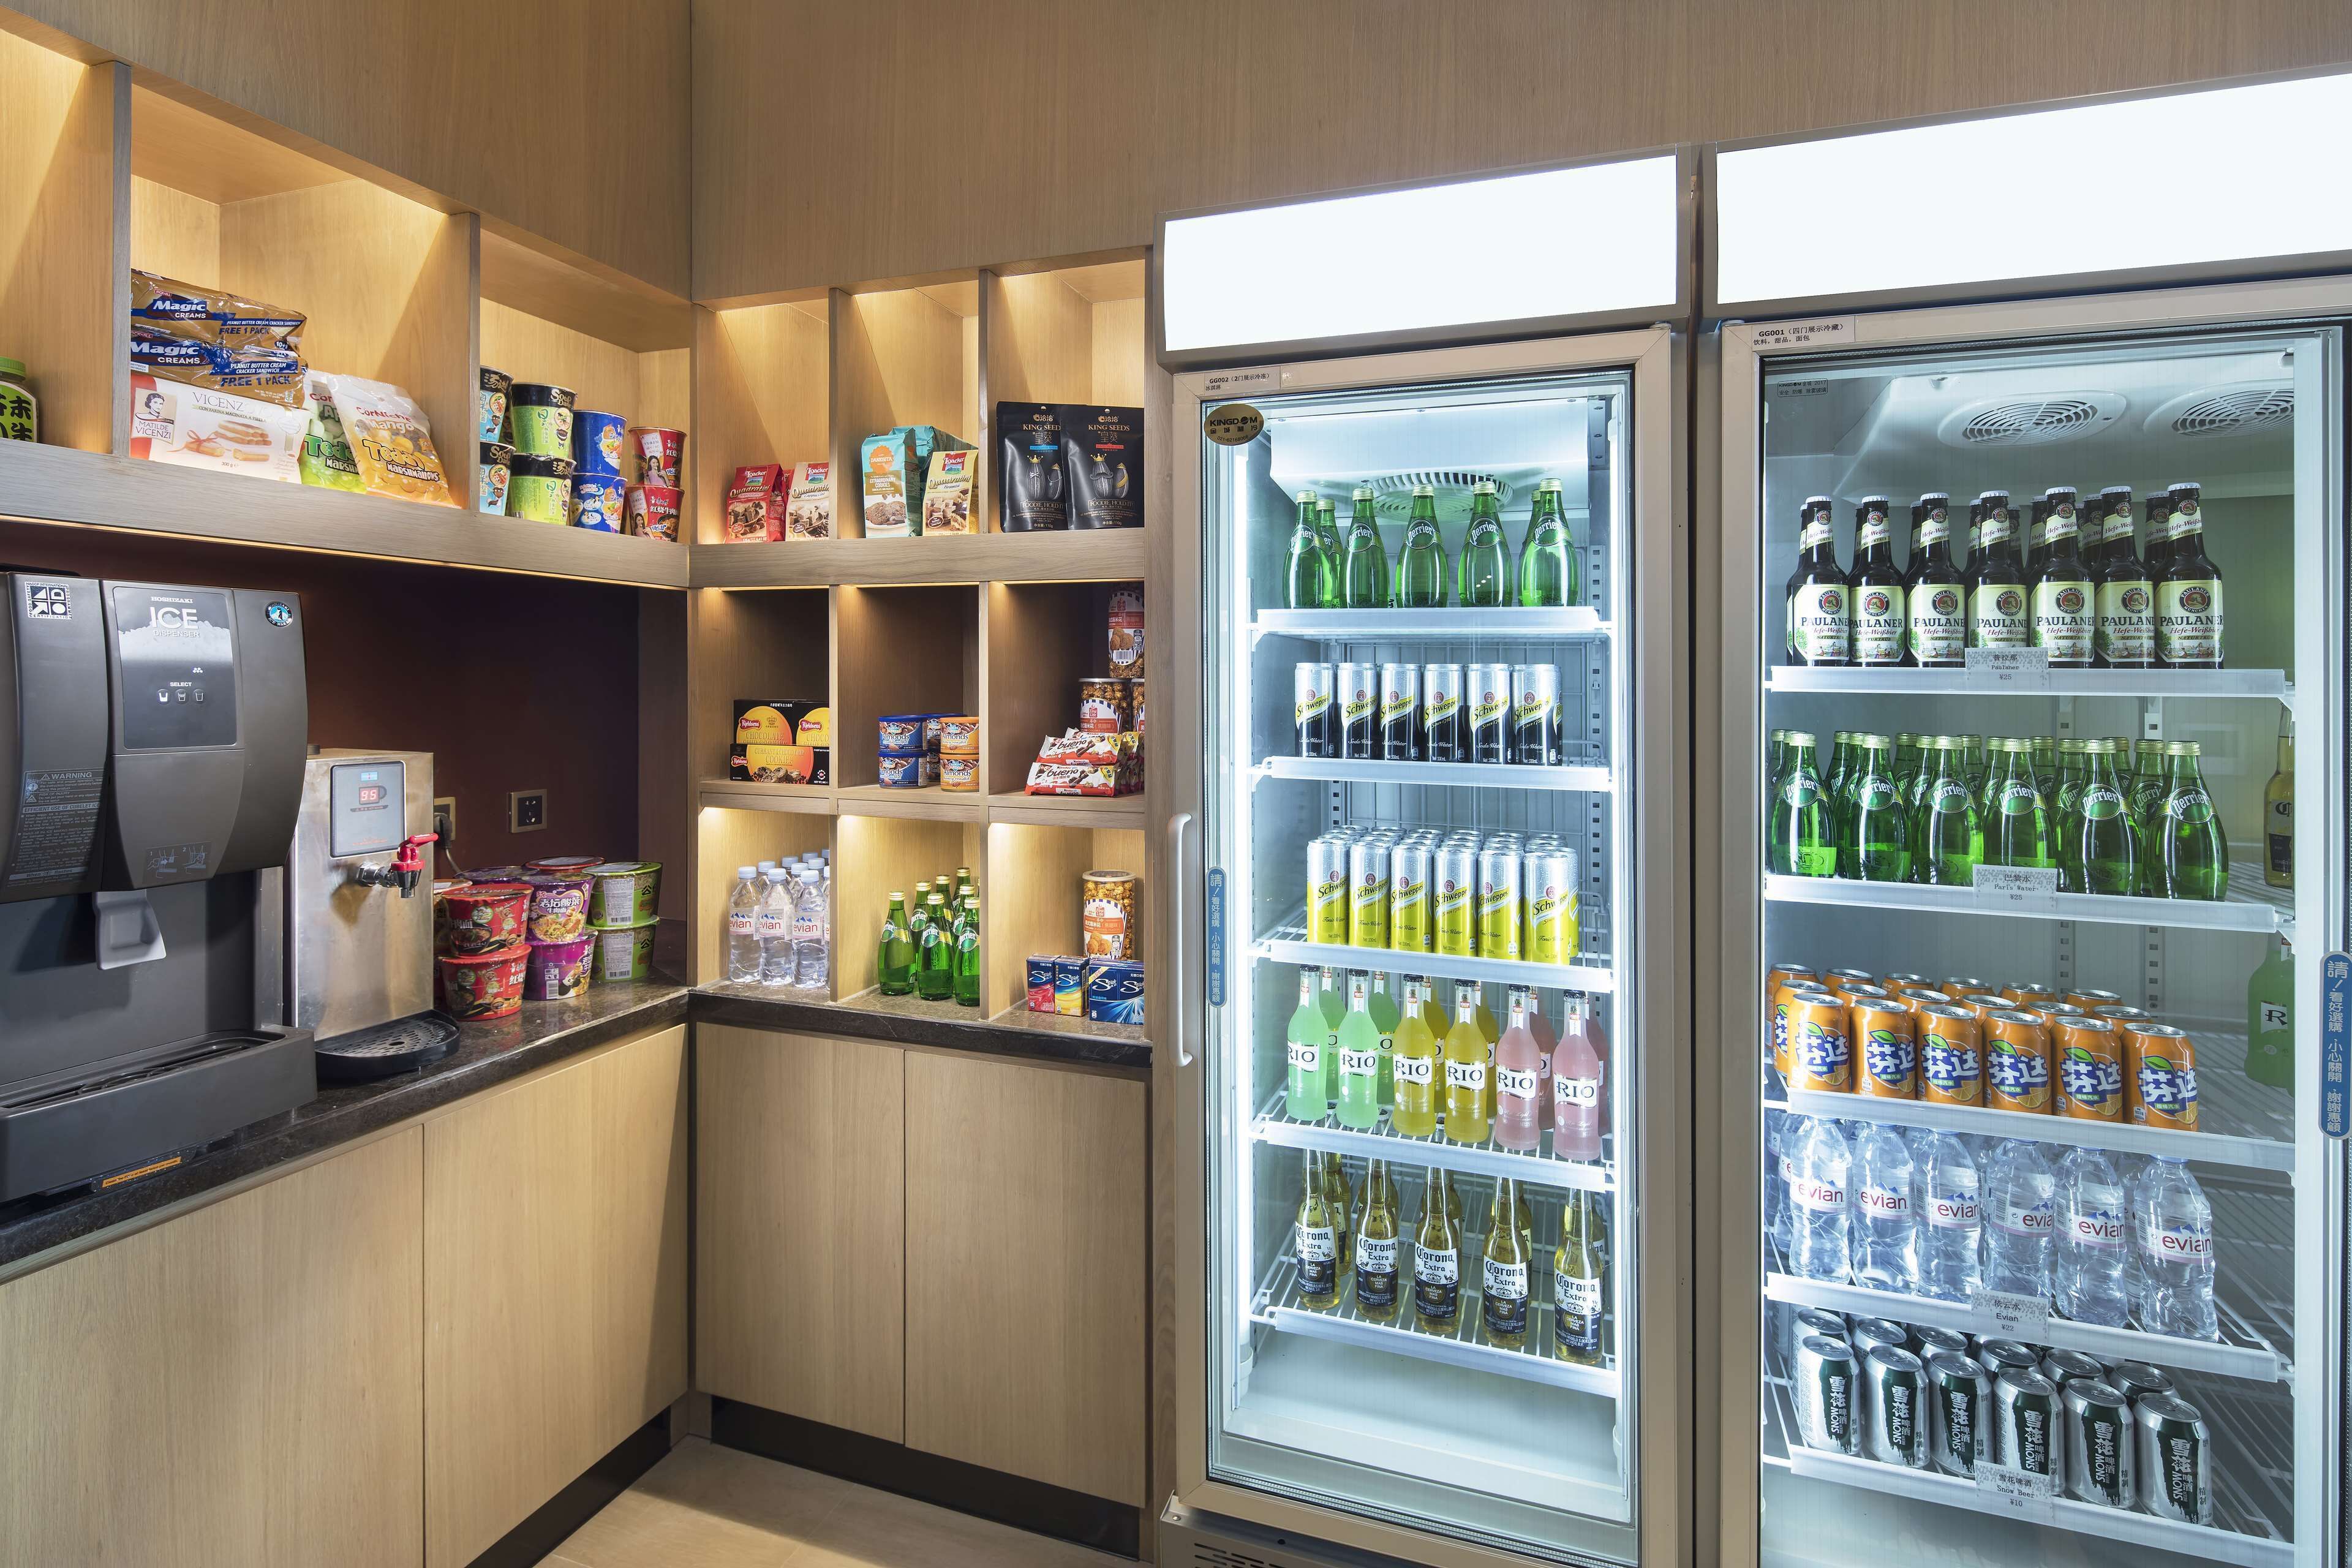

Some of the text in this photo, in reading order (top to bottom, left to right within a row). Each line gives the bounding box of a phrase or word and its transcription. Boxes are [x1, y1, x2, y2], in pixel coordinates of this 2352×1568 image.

[153, 299, 207, 311] Magic
[130, 341, 199, 355] Magic
[221, 376, 252, 387] FREE
[266, 376, 292, 385] PACK
[138, 421, 169, 430] MATILDE
[135, 428, 172, 439] VICENZI
[944, 456, 965, 465] Loacker
[729, 485, 770, 498] Quadratini
[150, 606, 200, 630] ICE
[1850, 617, 1903, 629] PAULANER
[1913, 617, 1966, 627] PAULANE
[2160, 615, 2223, 626] PAULANER
[742, 719, 760, 728] Kjeldsens
[1057, 739, 1087, 749] bueno
[1047, 769, 1079, 777] bueno
[2004, 873, 2031, 883] 巴黎水
[540, 896, 581, 907] 老坛酸菜
[794, 923, 818, 933] evian
[1343, 1054, 1376, 1068] RIO
[1921, 1046, 1980, 1079] 芬达
[1395, 1060, 1429, 1076] RIO
[1447, 1066, 1482, 1082] RIO
[1988, 1052, 2048, 1085] 芬达
[2061, 1060, 2122, 1093] 芬达
[1557, 1081, 1594, 1098] RIO
[1937, 1203, 1978, 1218] evian
[2078, 1221, 2125, 1238] evian
[2162, 1234, 2212, 1253] evian
[1417, 1247, 1455, 1262] Corona
[1423, 1262, 1446, 1272] Extra
[1485, 1261, 1525, 1277] Corona
[1494, 1275, 1515, 1286] Extra
[1994, 1298, 2021, 1311] 依云水
[1996, 1312, 2019, 1322] Evian
[2094, 1454, 2106, 1483] SNOW
[1999, 1474, 2032, 1488] 雪花啤酒
[2172, 1471, 2184, 1501] SNOW
[1997, 1485, 2035, 1498] Snow Beer
